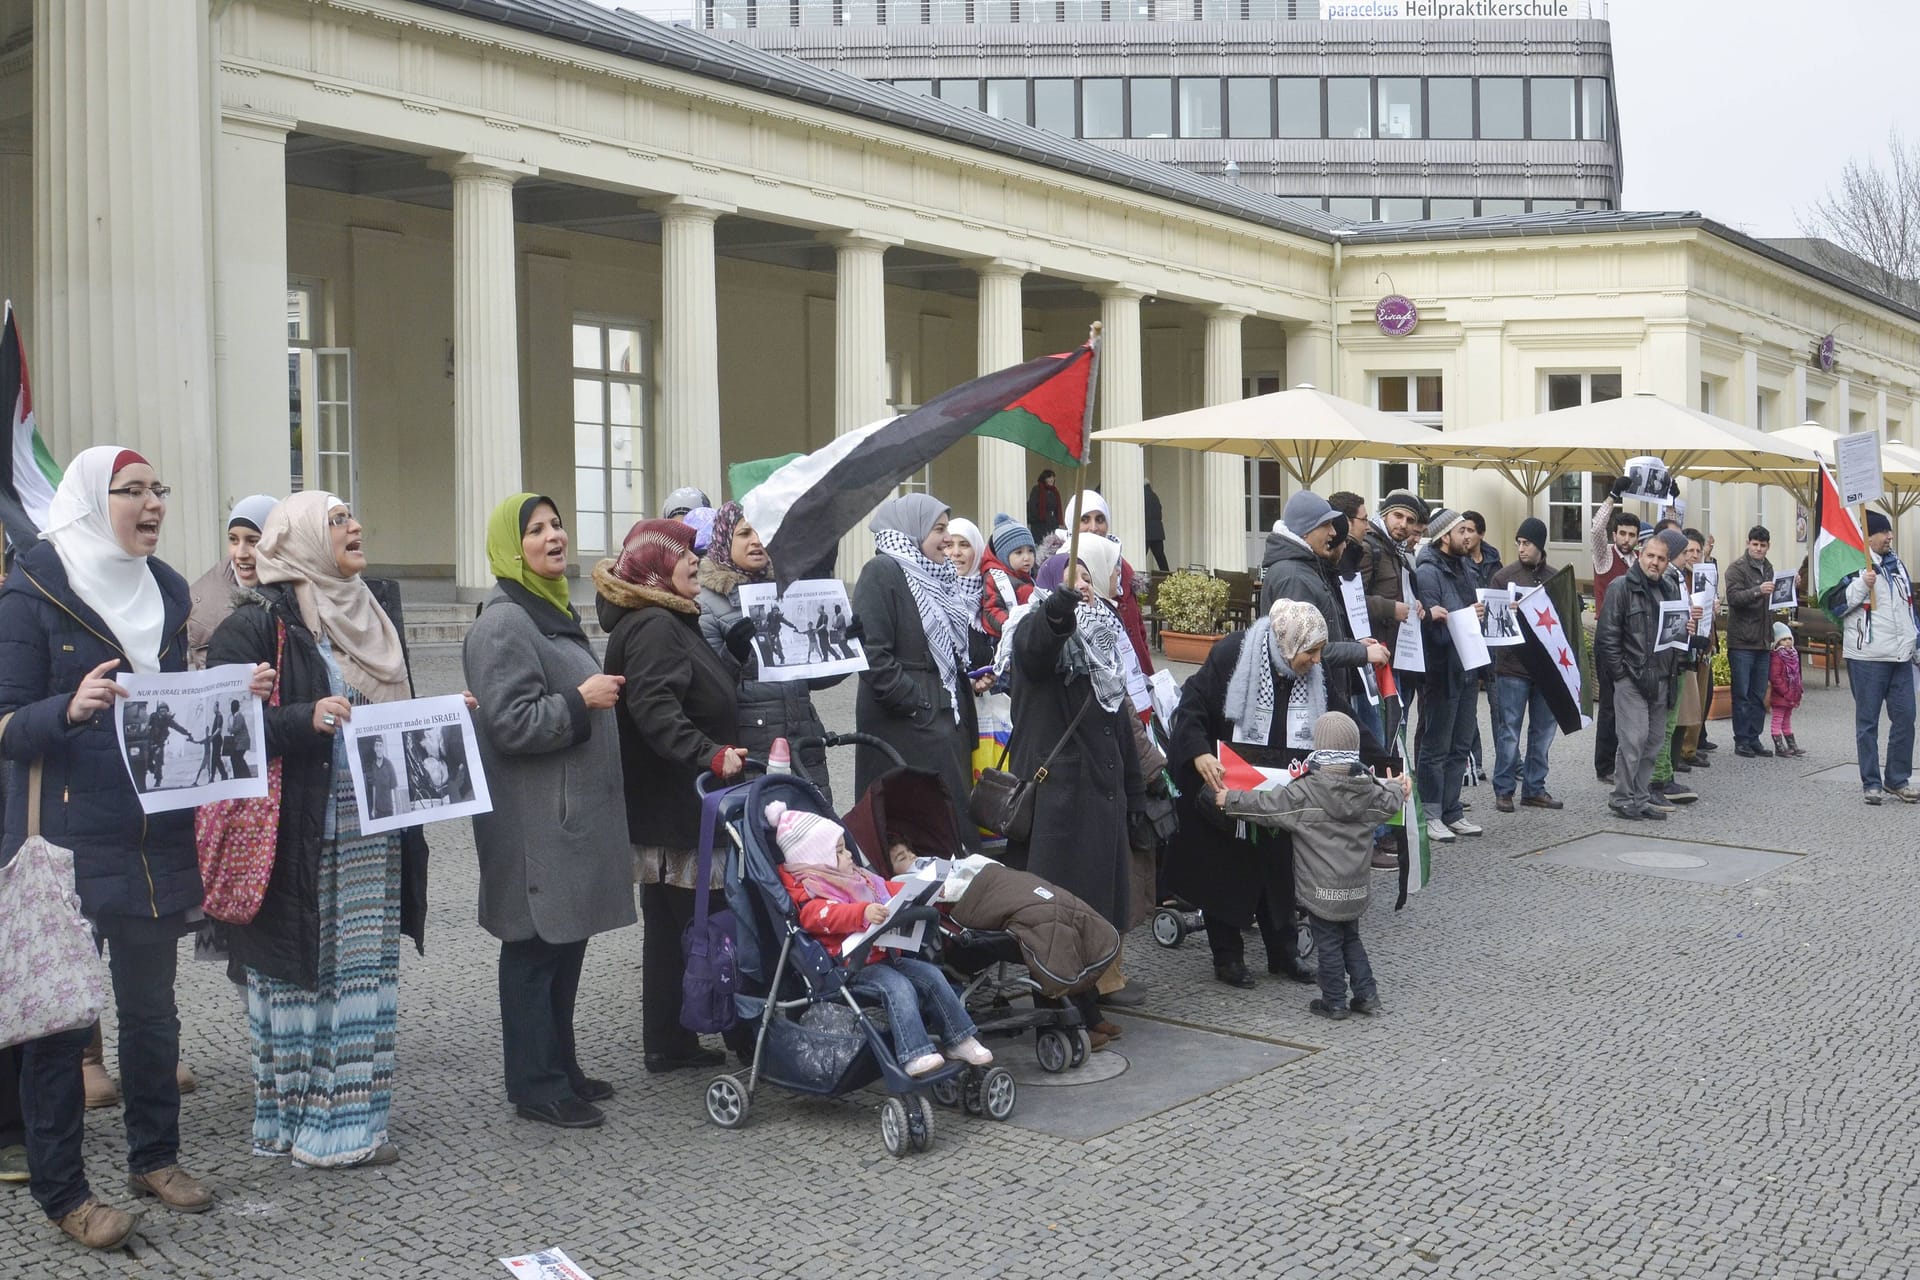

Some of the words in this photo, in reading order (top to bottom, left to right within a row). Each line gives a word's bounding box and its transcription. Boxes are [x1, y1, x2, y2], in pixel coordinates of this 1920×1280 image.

[1328, 0, 1399, 20] paracelsus
[1406, 0, 1568, 19] Heilpraktikerschule
[136, 689, 152, 697] NUR
[159, 688, 180, 696] ISRAEL
[404, 718, 422, 727] made
[423, 716, 431, 724] in
[431, 711, 461, 724] ISRAEL!
[1315, 886, 1350, 901] FOREST
